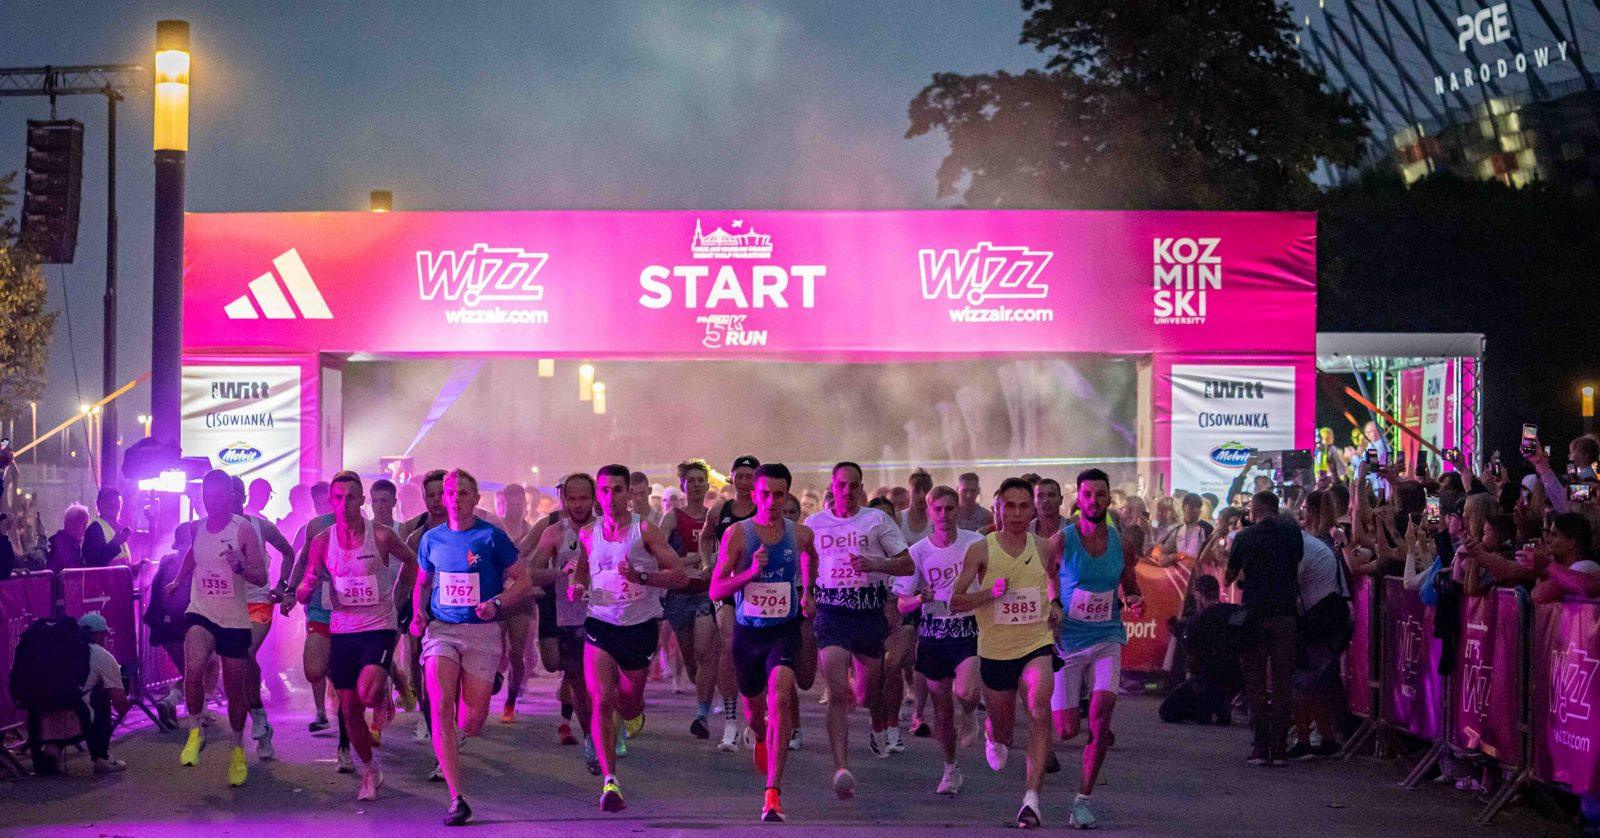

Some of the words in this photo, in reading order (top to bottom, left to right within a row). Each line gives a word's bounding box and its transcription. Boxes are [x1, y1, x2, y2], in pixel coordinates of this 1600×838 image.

[1457, 3, 1510, 52] PGE
[1435, 41, 1567, 95] NARODOWY
[1153, 237, 1222, 264] KOZ
[1153, 264, 1222, 290] MIN
[638, 265, 827, 309] START
[1153, 290, 1206, 317] SKI
[445, 307, 548, 324] wizzair.com
[948, 305, 1054, 322] wizzair.com
[1154, 317, 1206, 325] UNIVERSITY
[725, 330, 768, 346] RUN
[205, 412, 274, 428] CISOWIANKA
[1198, 412, 1268, 429] CISOWIANKA
[820, 531, 869, 549] Delia
[201, 579, 228, 590] 1335
[344, 587, 373, 598] 2816
[445, 585, 474, 596] 1767
[751, 595, 787, 606] 3704
[1002, 601, 1037, 614] 3883
[1077, 602, 1110, 614] 4666
